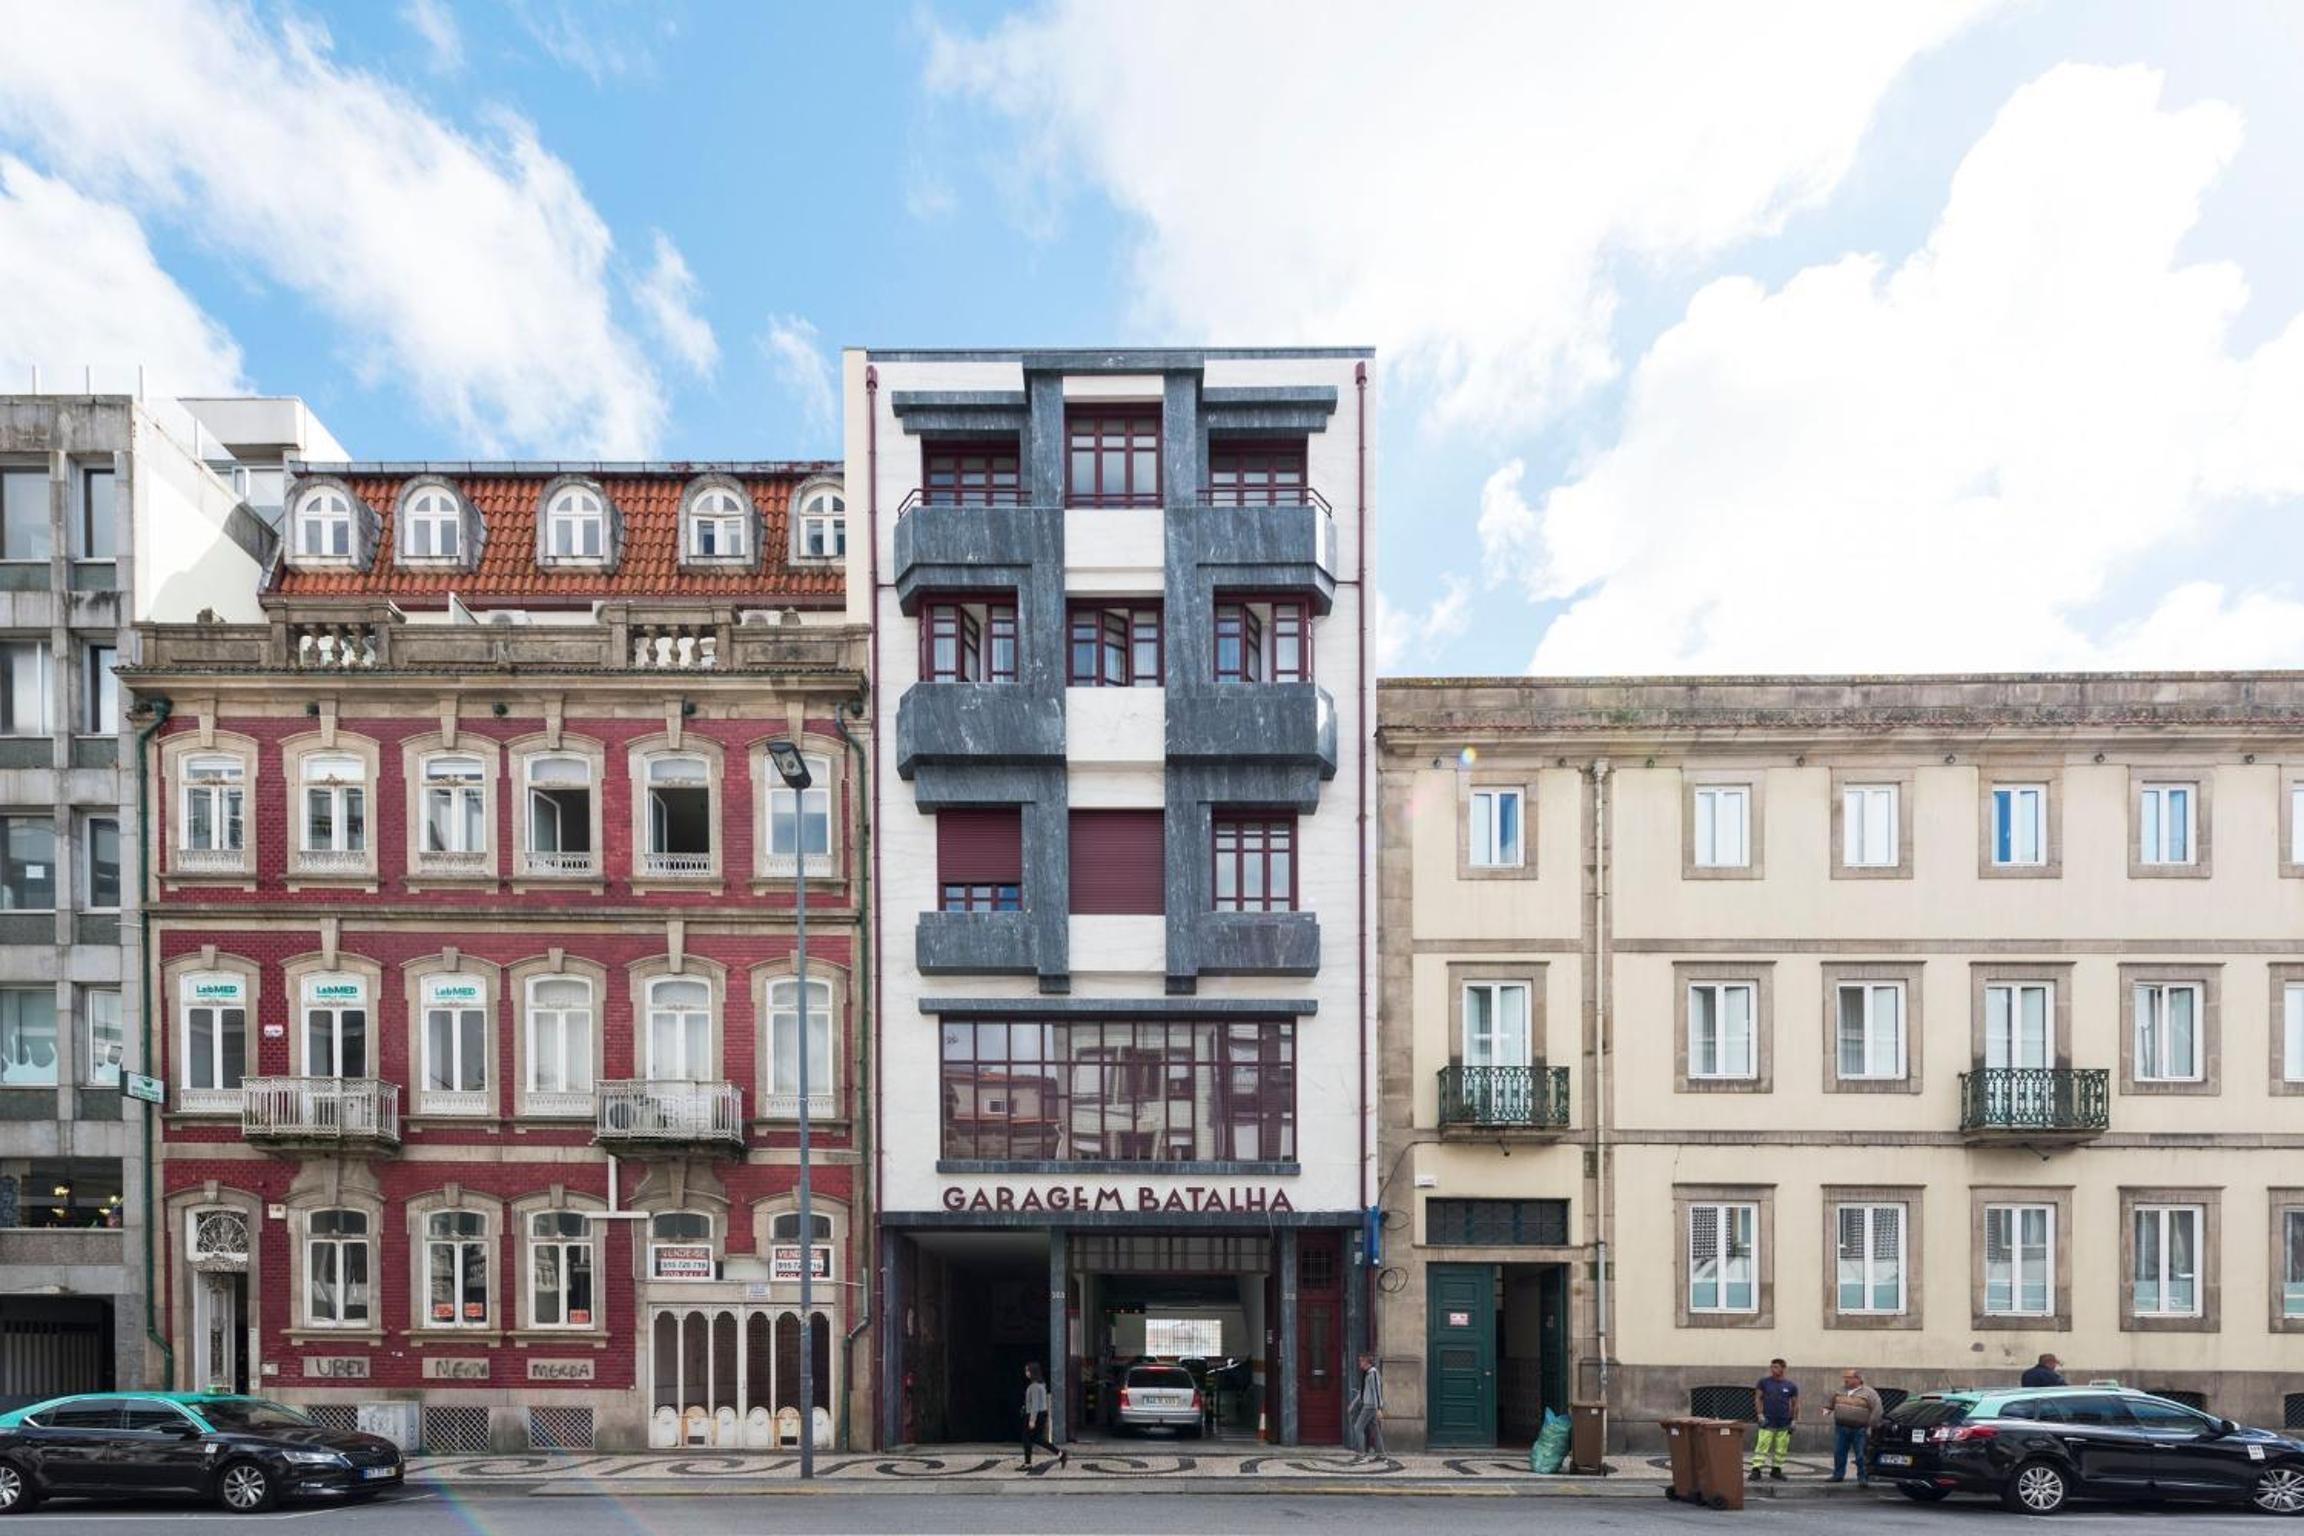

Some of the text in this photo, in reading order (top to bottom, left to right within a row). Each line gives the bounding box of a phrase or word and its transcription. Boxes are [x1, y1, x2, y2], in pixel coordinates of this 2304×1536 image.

[196, 985, 238, 993] LabMED
[316, 986, 358, 994] LabMED
[434, 987, 476, 996] LabMED
[942, 1186, 1295, 1212] GARAGEM BATALHA
[316, 1359, 367, 1376] UBER
